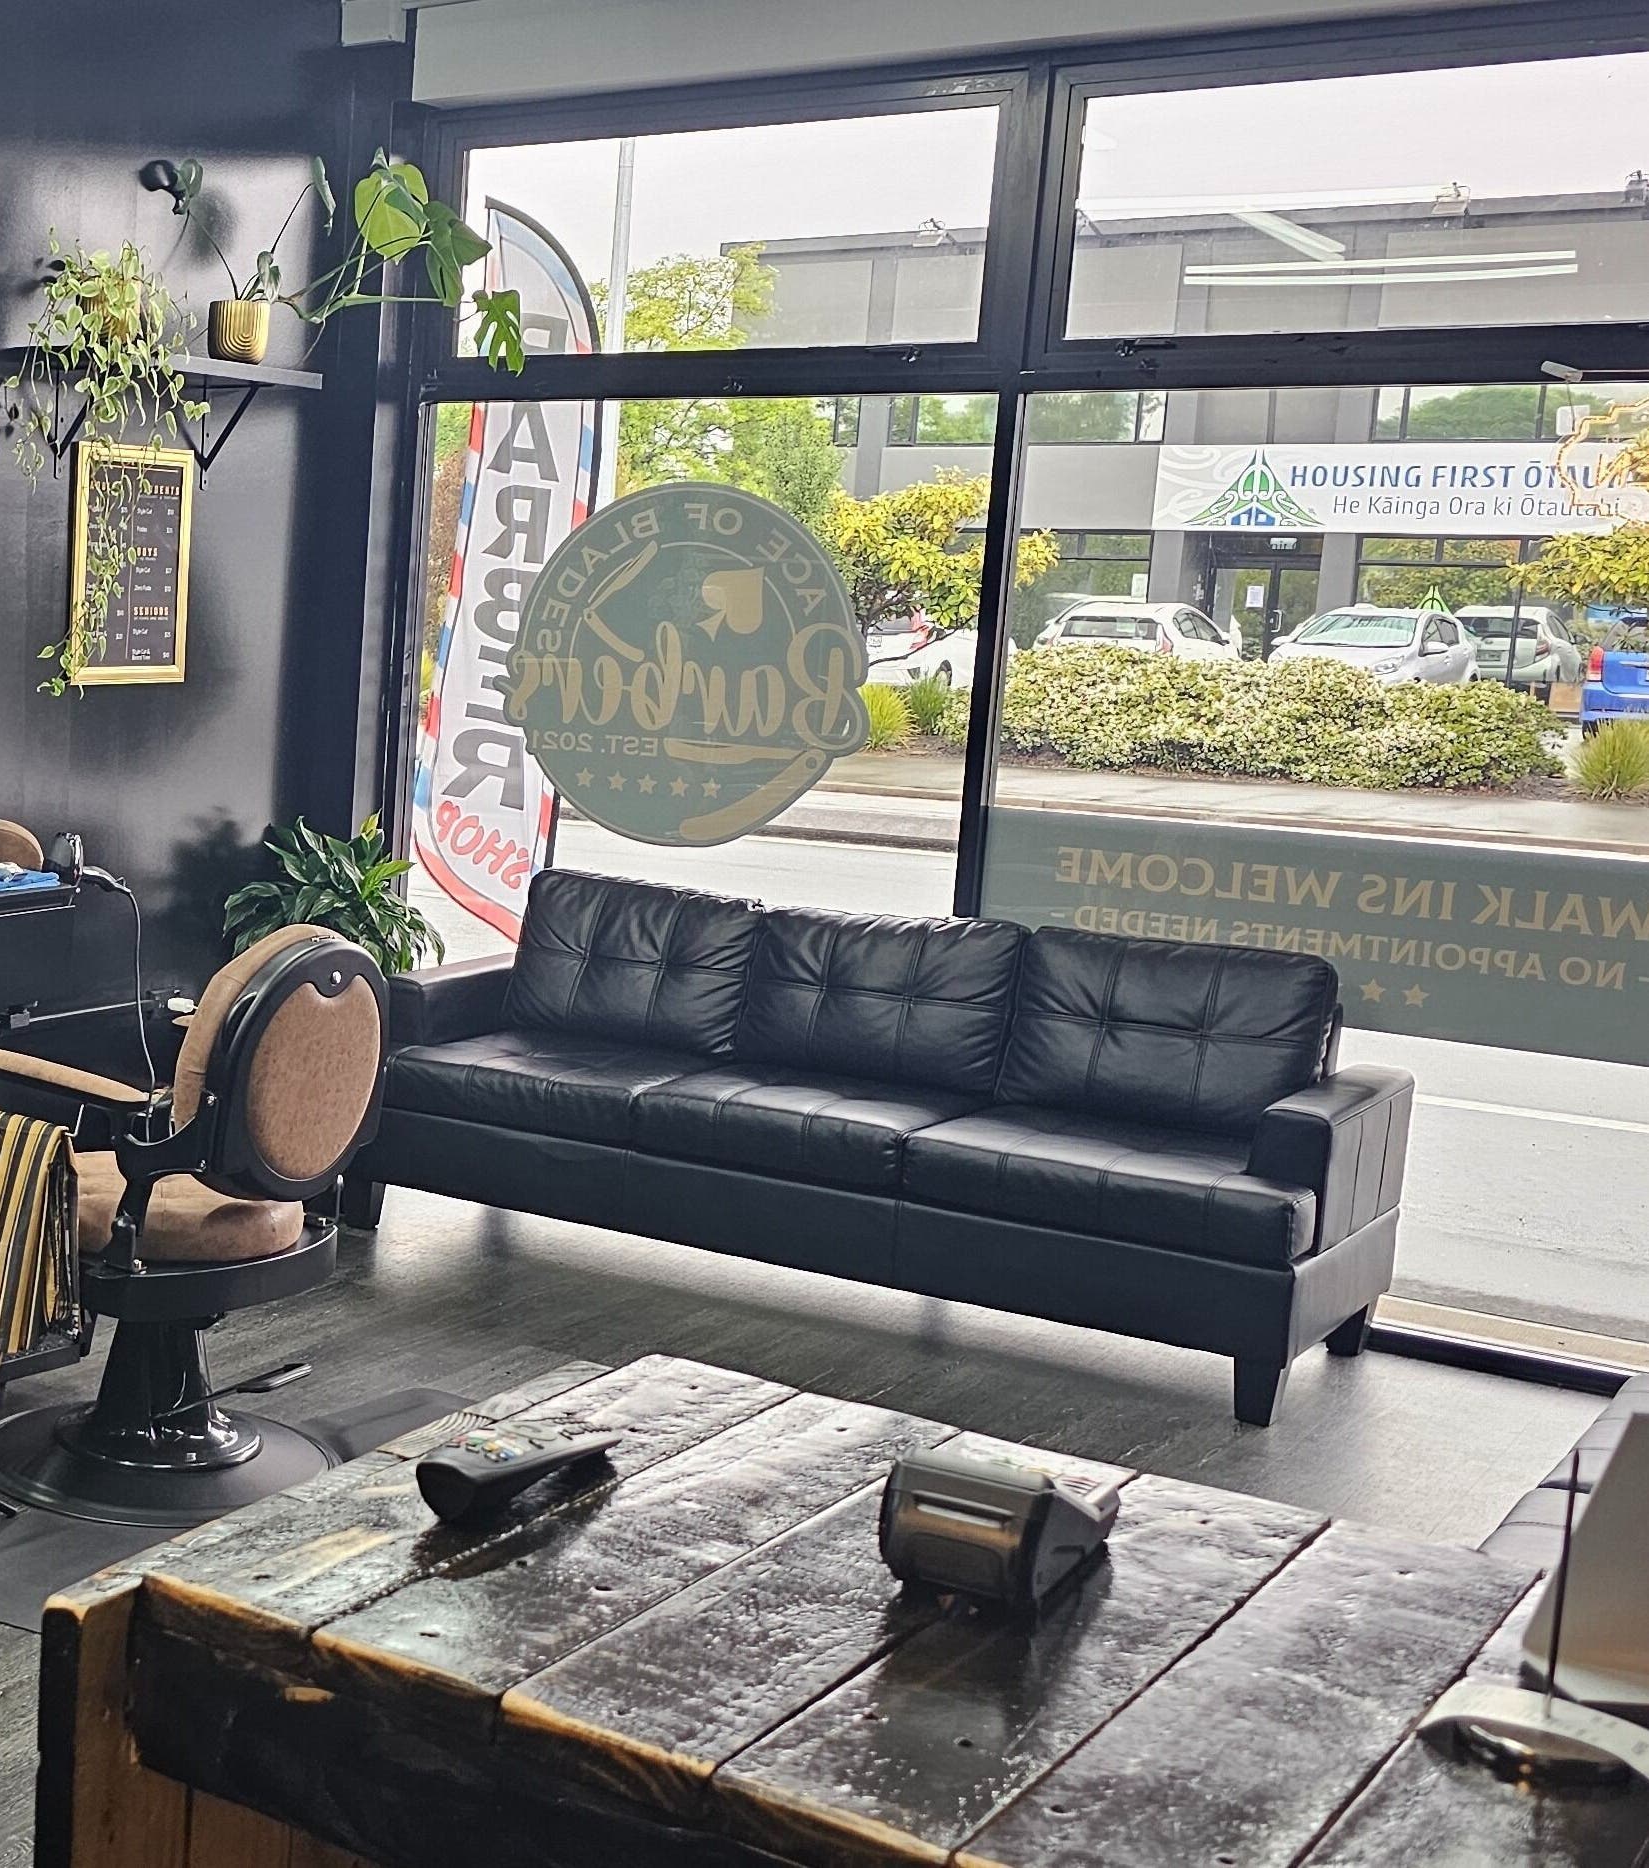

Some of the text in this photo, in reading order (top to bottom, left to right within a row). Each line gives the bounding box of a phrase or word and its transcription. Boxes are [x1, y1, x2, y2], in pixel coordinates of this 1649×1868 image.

[1290, 465, 1422, 488] HOUSING
[1431, 465, 1515, 488] FIRST
[1333, 493, 1620, 519] He Kāinga Ora ki Ōtautahi
